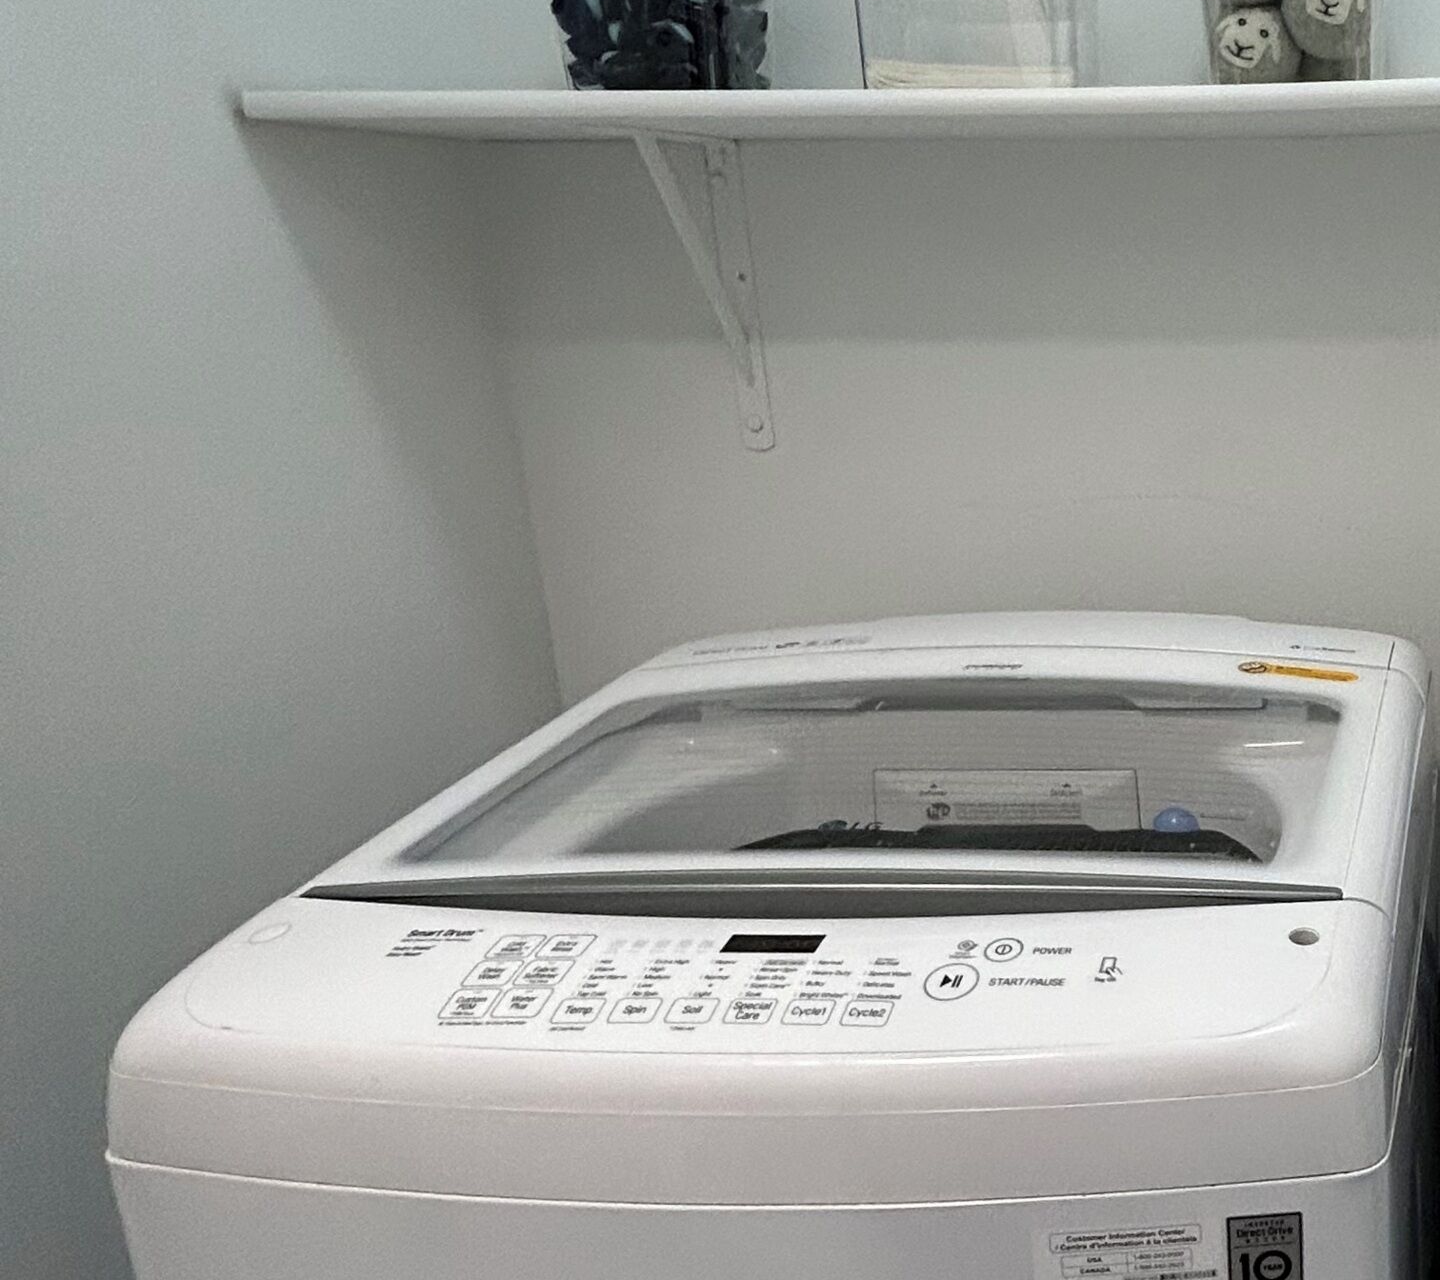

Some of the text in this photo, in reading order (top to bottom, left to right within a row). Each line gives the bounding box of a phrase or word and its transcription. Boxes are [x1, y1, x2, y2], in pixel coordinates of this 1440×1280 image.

[1033, 947, 1072, 955] POWER
[988, 978, 1066, 987] START/PAUSE
[565, 1005, 593, 1016] Temp
[622, 1004, 647, 1016] Spin
[682, 1005, 703, 1014] Soil
[733, 1001, 773, 1012] Special
[790, 1006, 826, 1017] Cycle1
[735, 1011, 760, 1020] Care
[848, 1007, 886, 1018] Cycle2
[1066, 1228, 1186, 1243] Customer Information Center
[1237, 1226, 1293, 1238] Direct Drive
